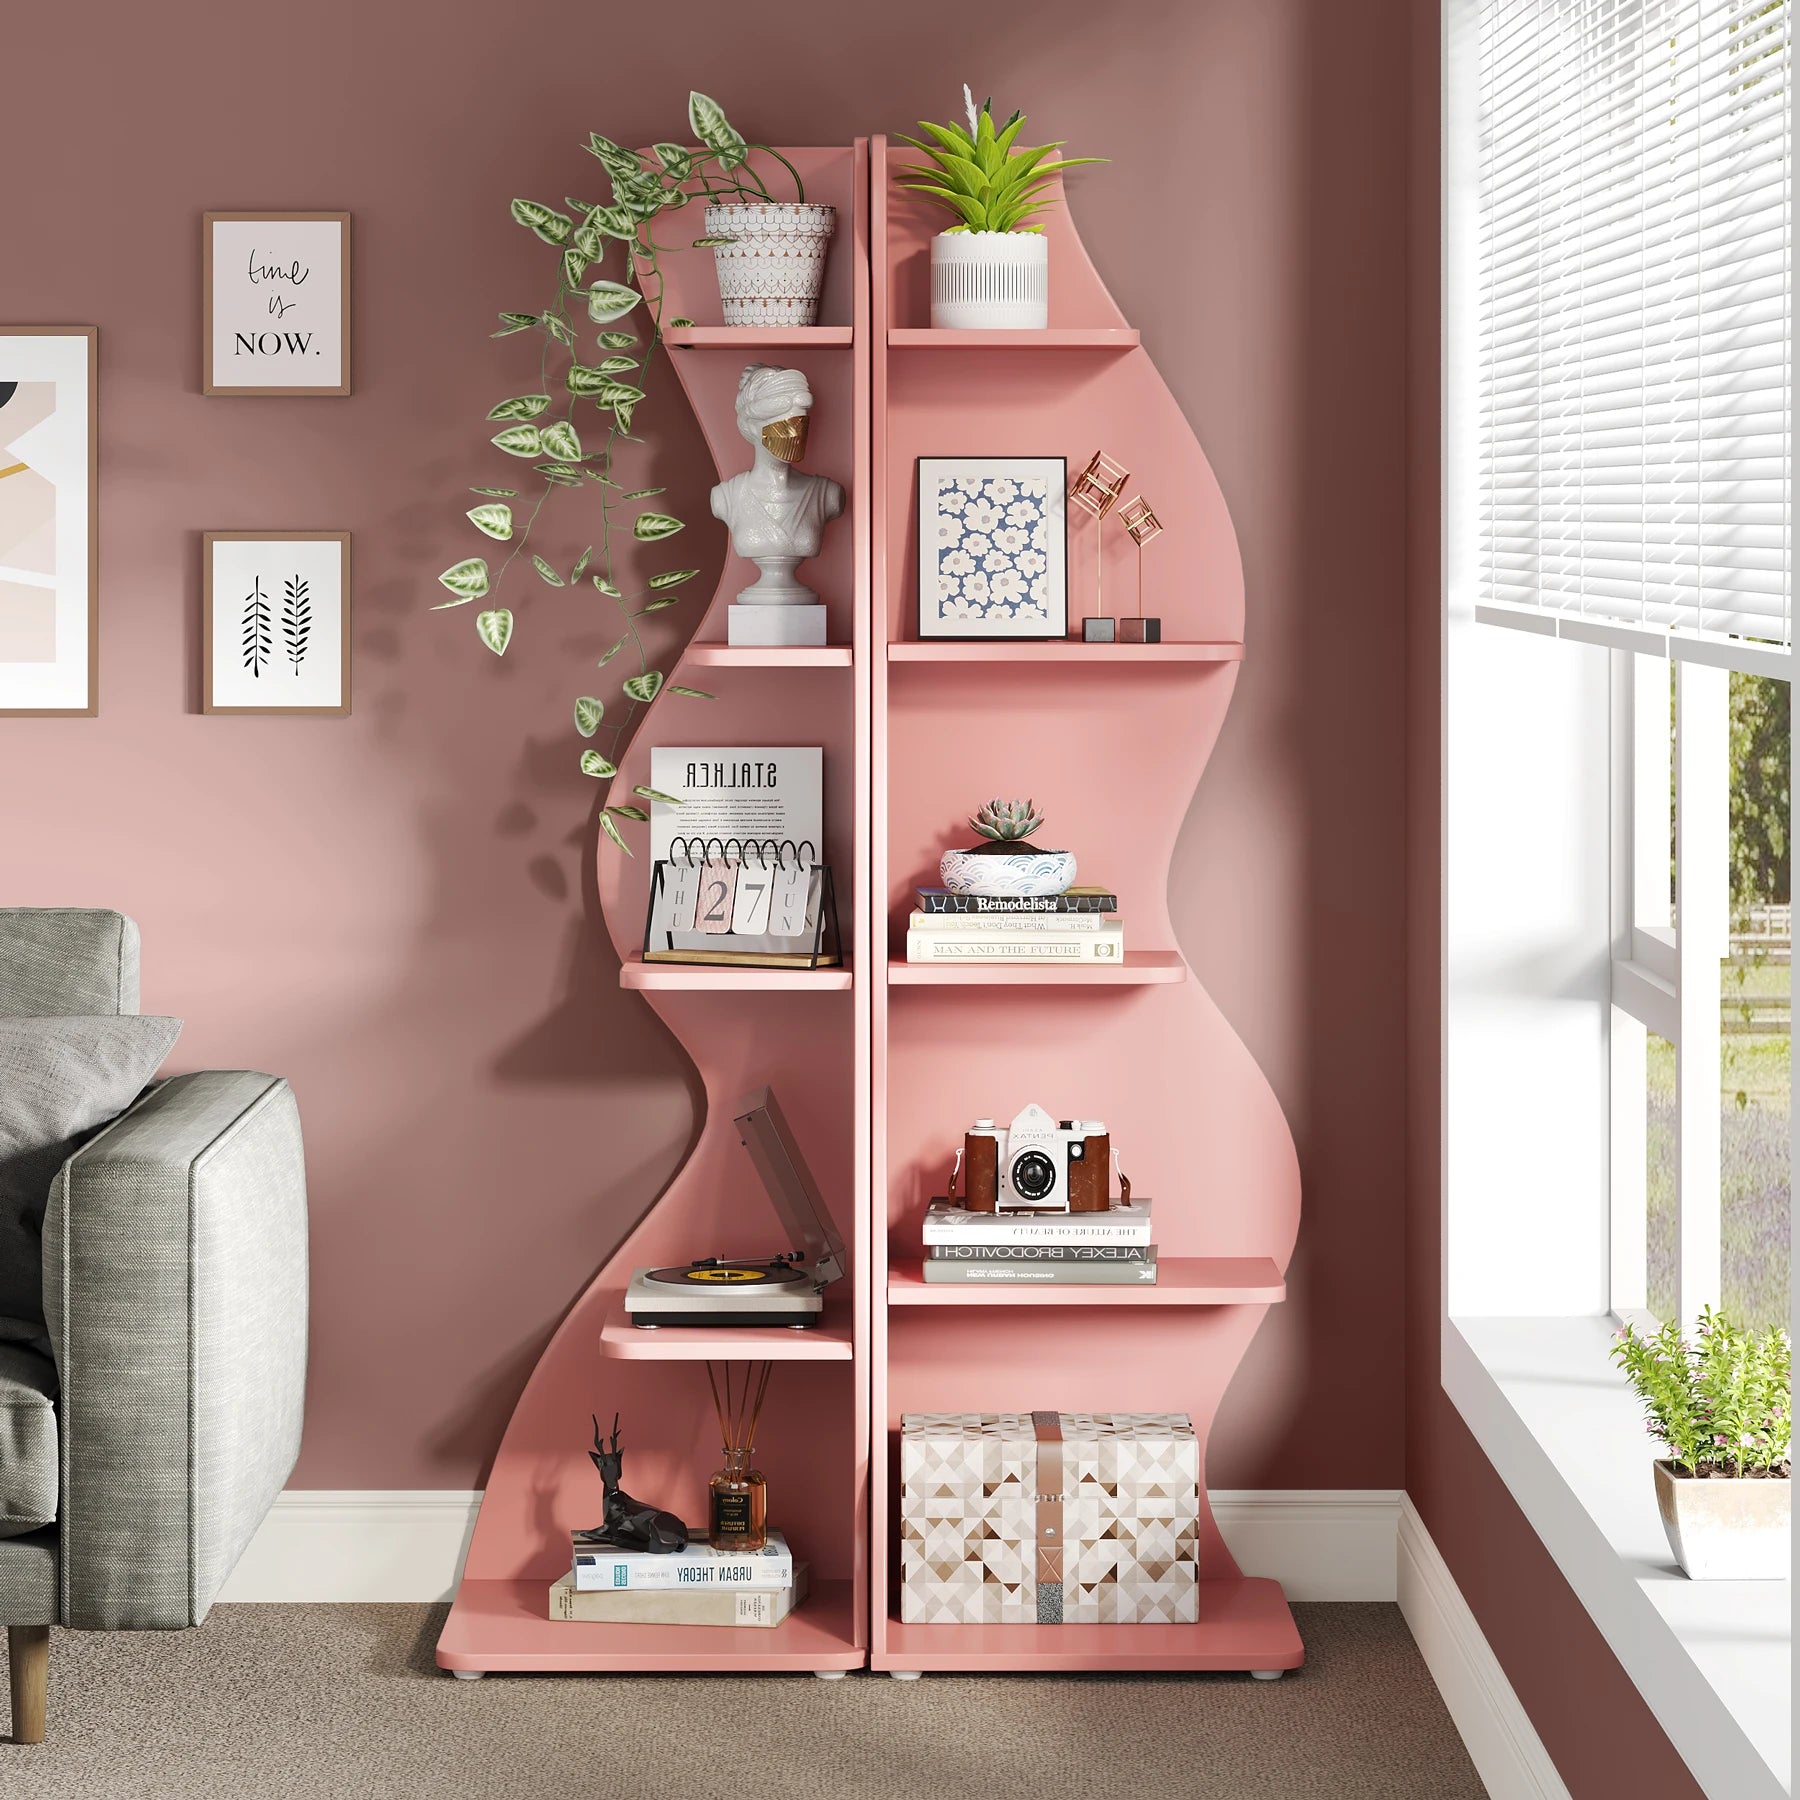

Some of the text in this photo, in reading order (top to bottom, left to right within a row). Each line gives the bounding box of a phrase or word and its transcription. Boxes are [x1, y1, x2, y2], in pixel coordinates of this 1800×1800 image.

[248, 249, 309, 285] time
[268, 289, 296, 319] is
[234, 332, 321, 356] NOW.
[978, 896, 1058, 911] Remodelista
[982, 921, 1002, 930] Don't
[1003, 920, 1022, 930] They
[1024, 921, 1045, 930] What
[934, 946, 1081, 954] MAN AND THE FUTURE
